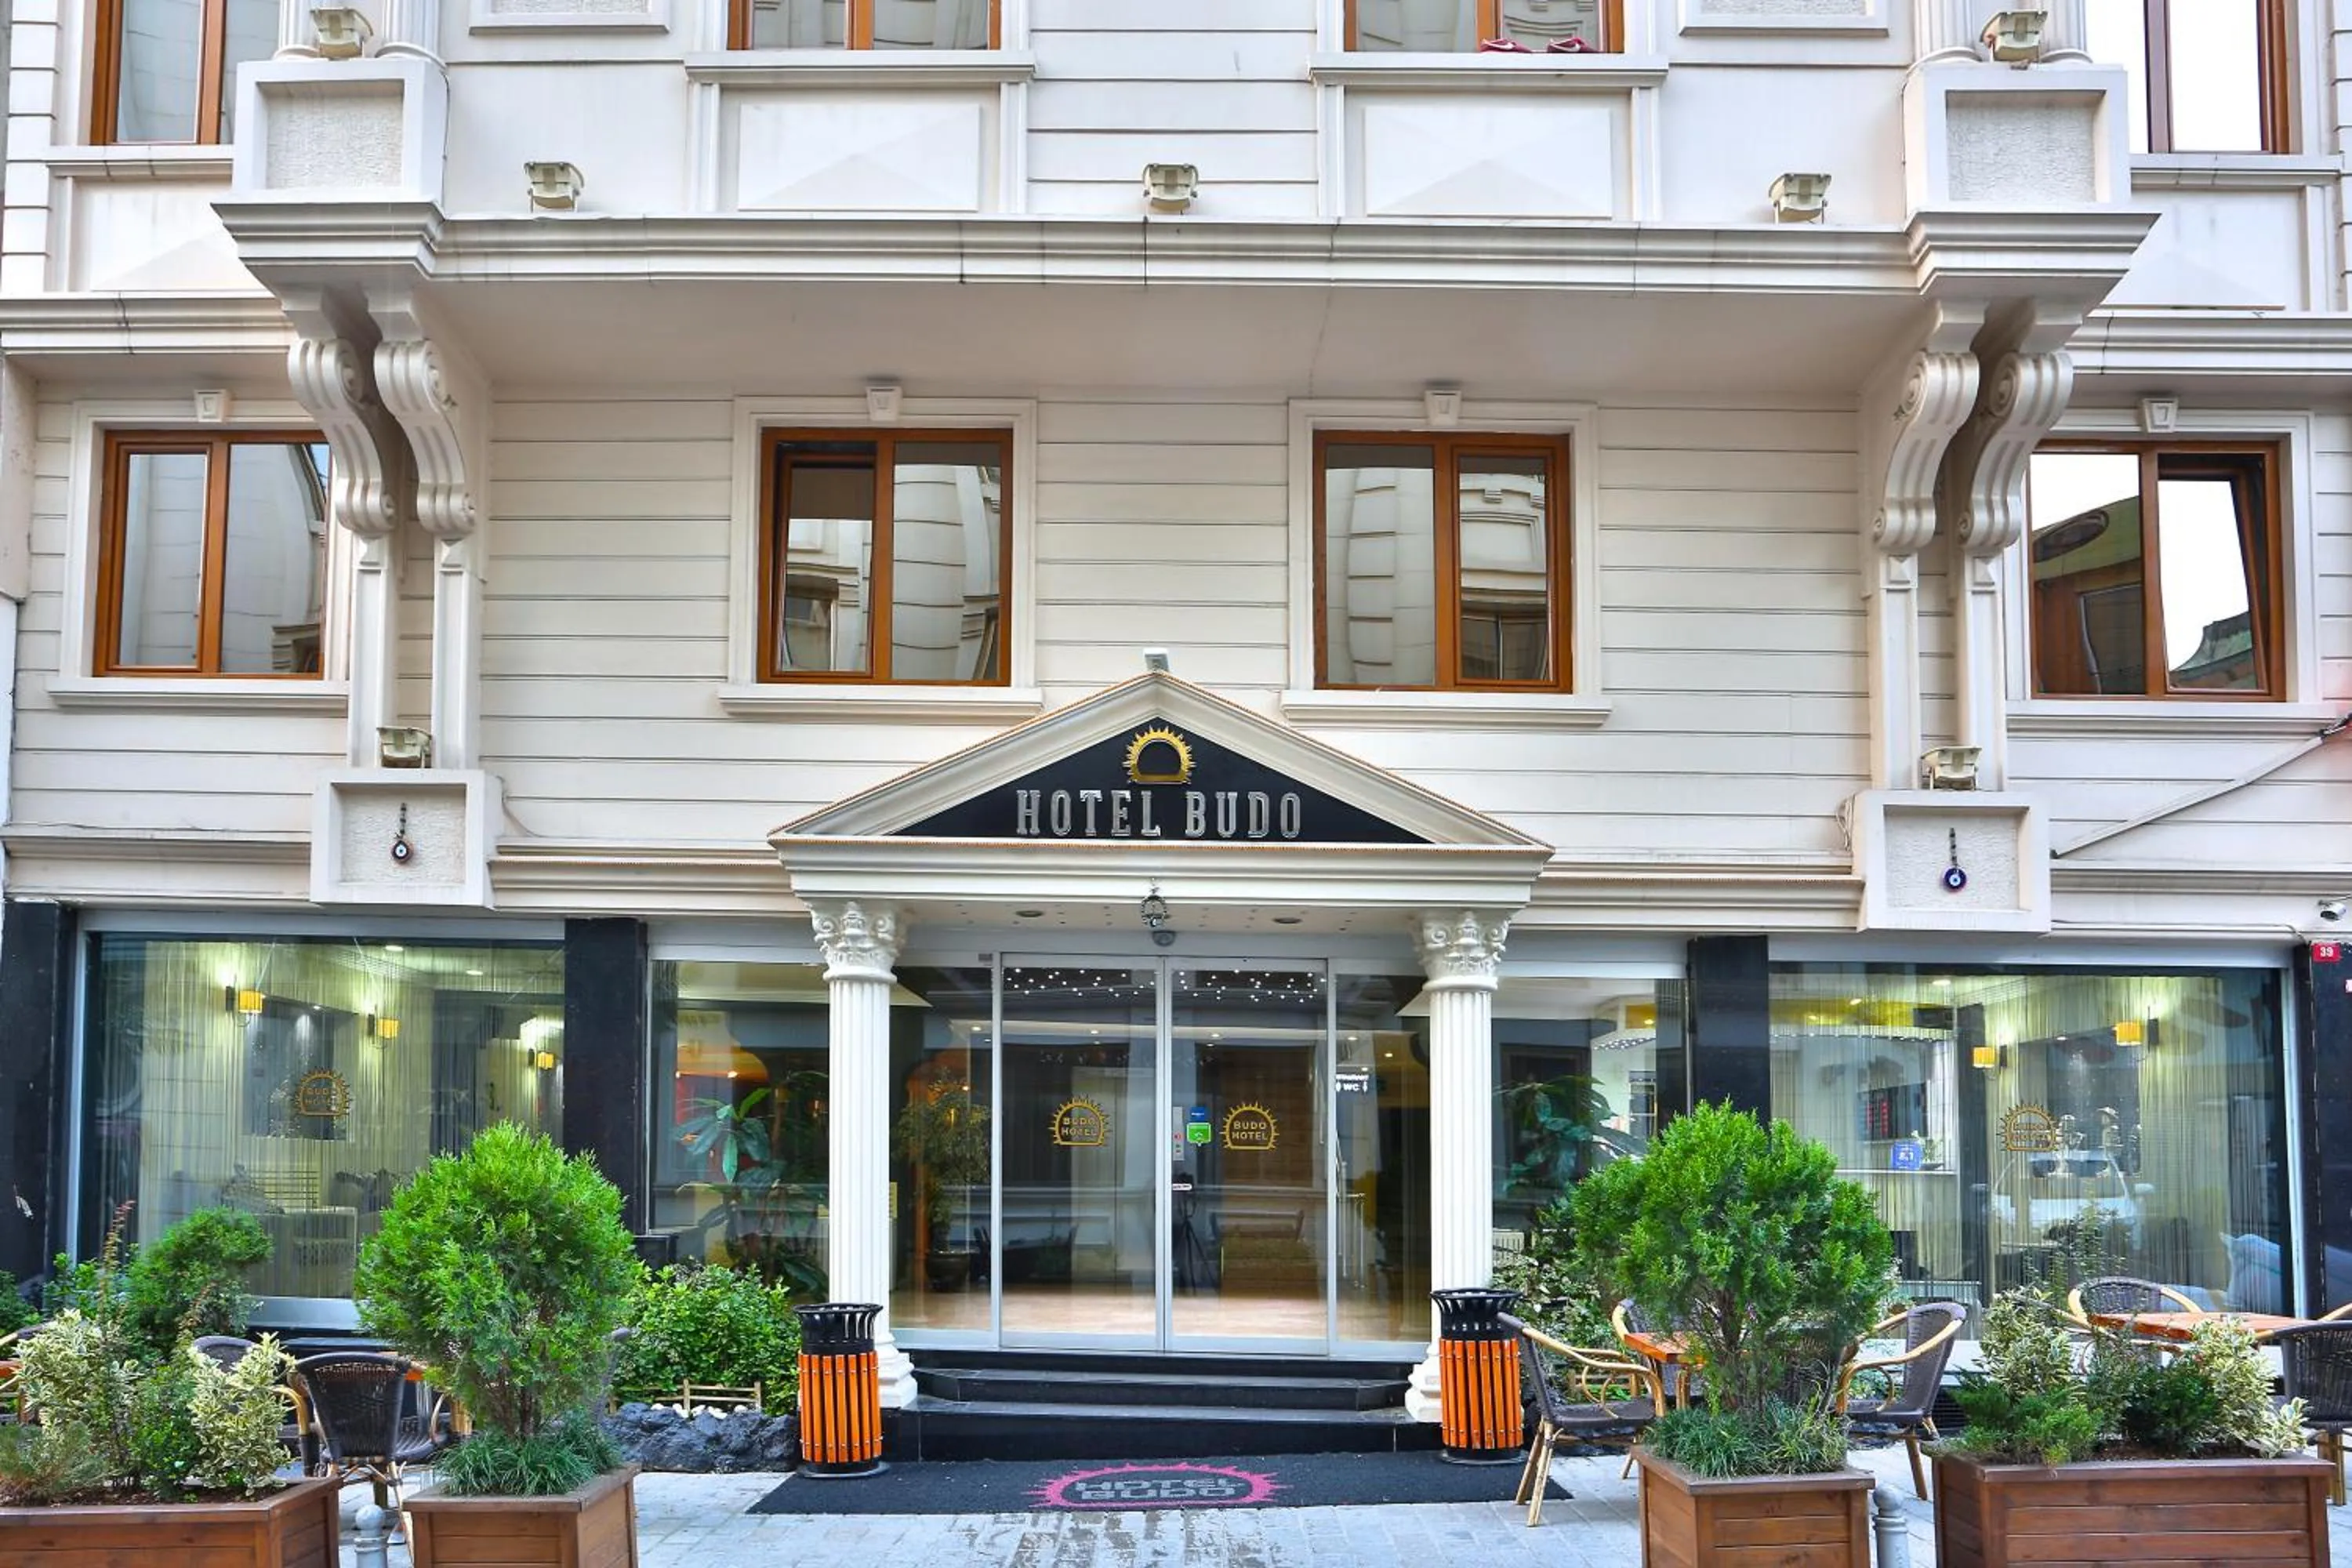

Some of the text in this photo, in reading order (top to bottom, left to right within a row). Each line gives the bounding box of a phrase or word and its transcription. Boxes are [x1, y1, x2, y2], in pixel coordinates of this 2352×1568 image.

[1016, 789, 1301, 838] HOTEL BUDO
[1343, 1083, 1360, 1091] WC
[1062, 1117, 1096, 1126] BUDO
[1233, 1120, 1267, 1130] BUDO
[1061, 1127, 1098, 1136] HOTEL
[1232, 1131, 1268, 1141] HOTEL
